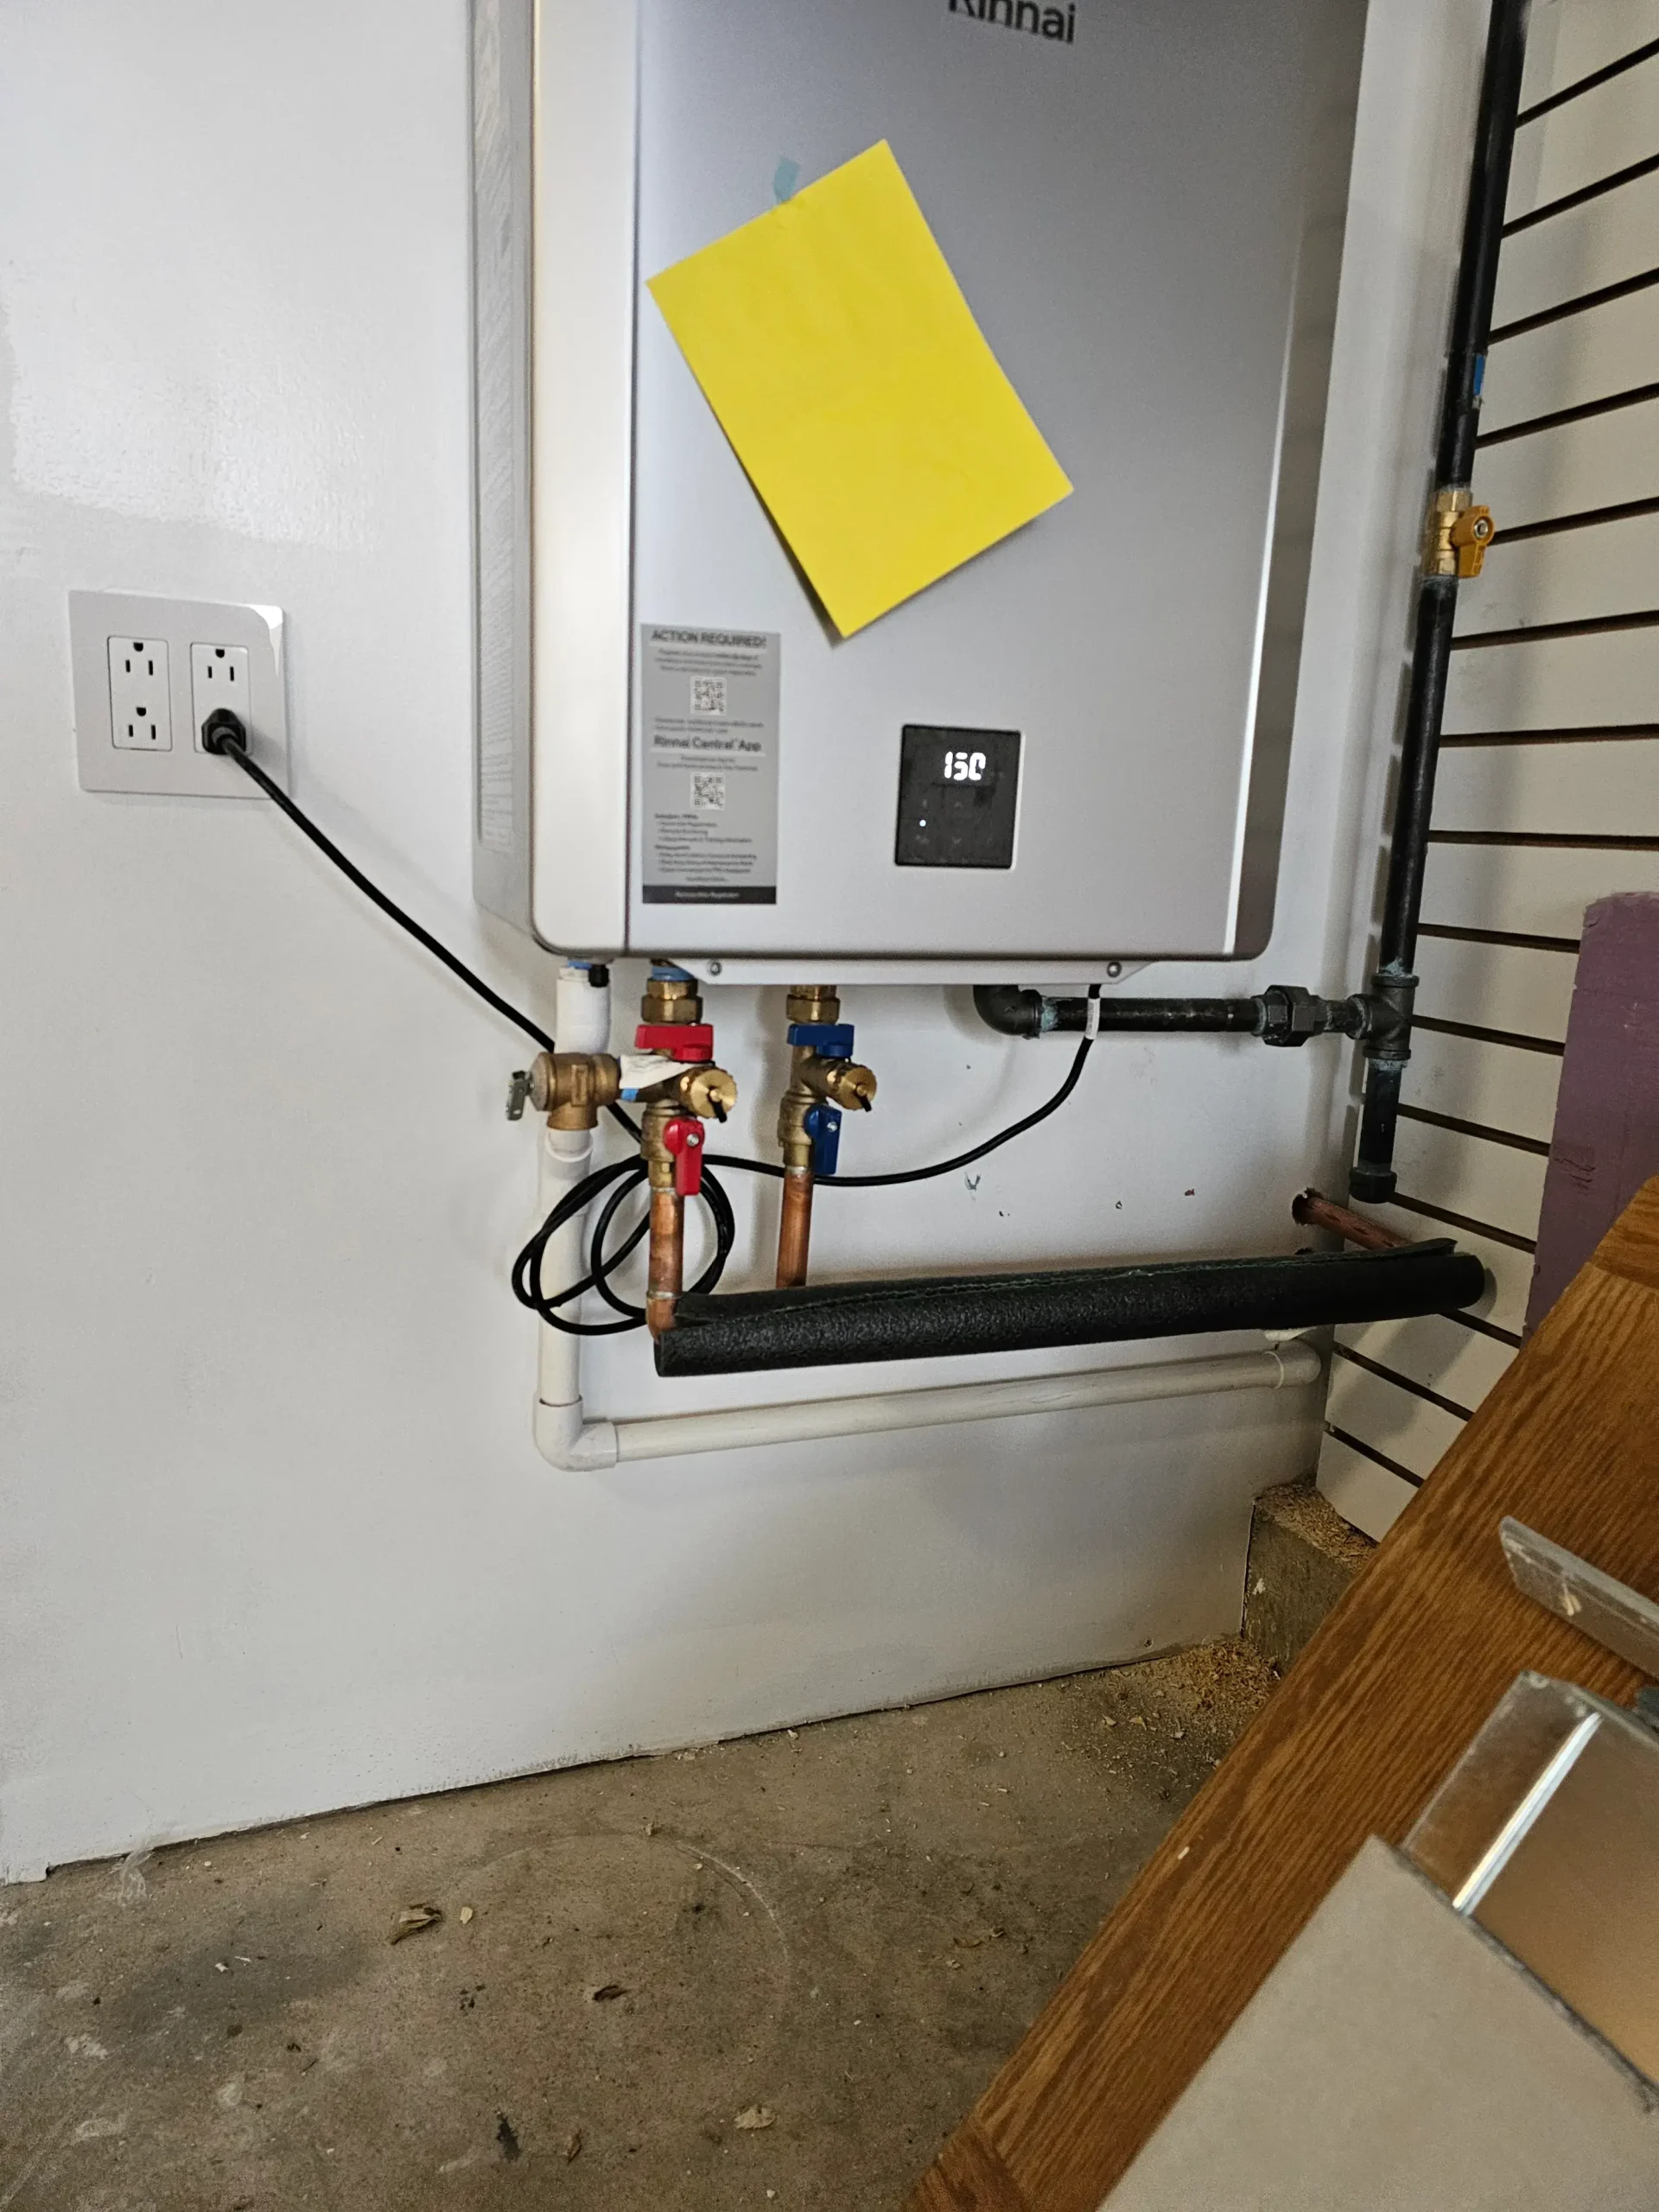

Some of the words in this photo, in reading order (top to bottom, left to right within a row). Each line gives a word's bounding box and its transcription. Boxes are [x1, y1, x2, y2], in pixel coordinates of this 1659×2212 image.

[651, 628, 698, 644] ACTION
[700, 632, 766, 648] REQUIRED!
[738, 740, 762, 752] App
[944, 751, 987, 781] 150
